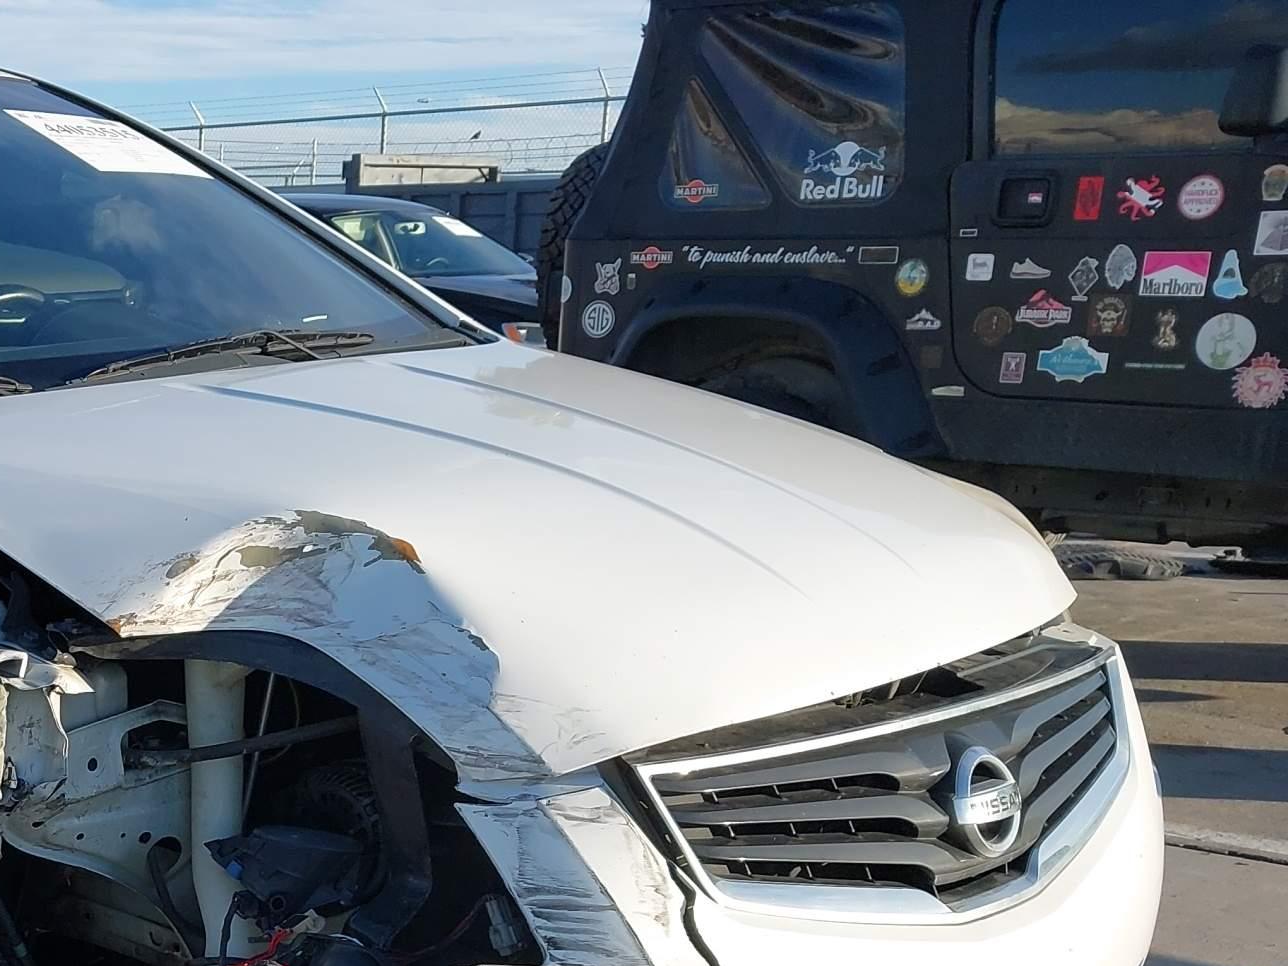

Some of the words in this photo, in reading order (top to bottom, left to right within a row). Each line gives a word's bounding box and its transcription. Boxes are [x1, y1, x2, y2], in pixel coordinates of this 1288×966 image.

[676, 187, 717, 196] MARTINI
[800, 177, 841, 200] Red
[842, 175, 884, 199] Bull
[632, 253, 672, 263] MARTINI
[699, 245, 752, 270] punish
[751, 247, 784, 263] and
[1141, 277, 1204, 295] Marlboro
[585, 303, 612, 335] SIG
